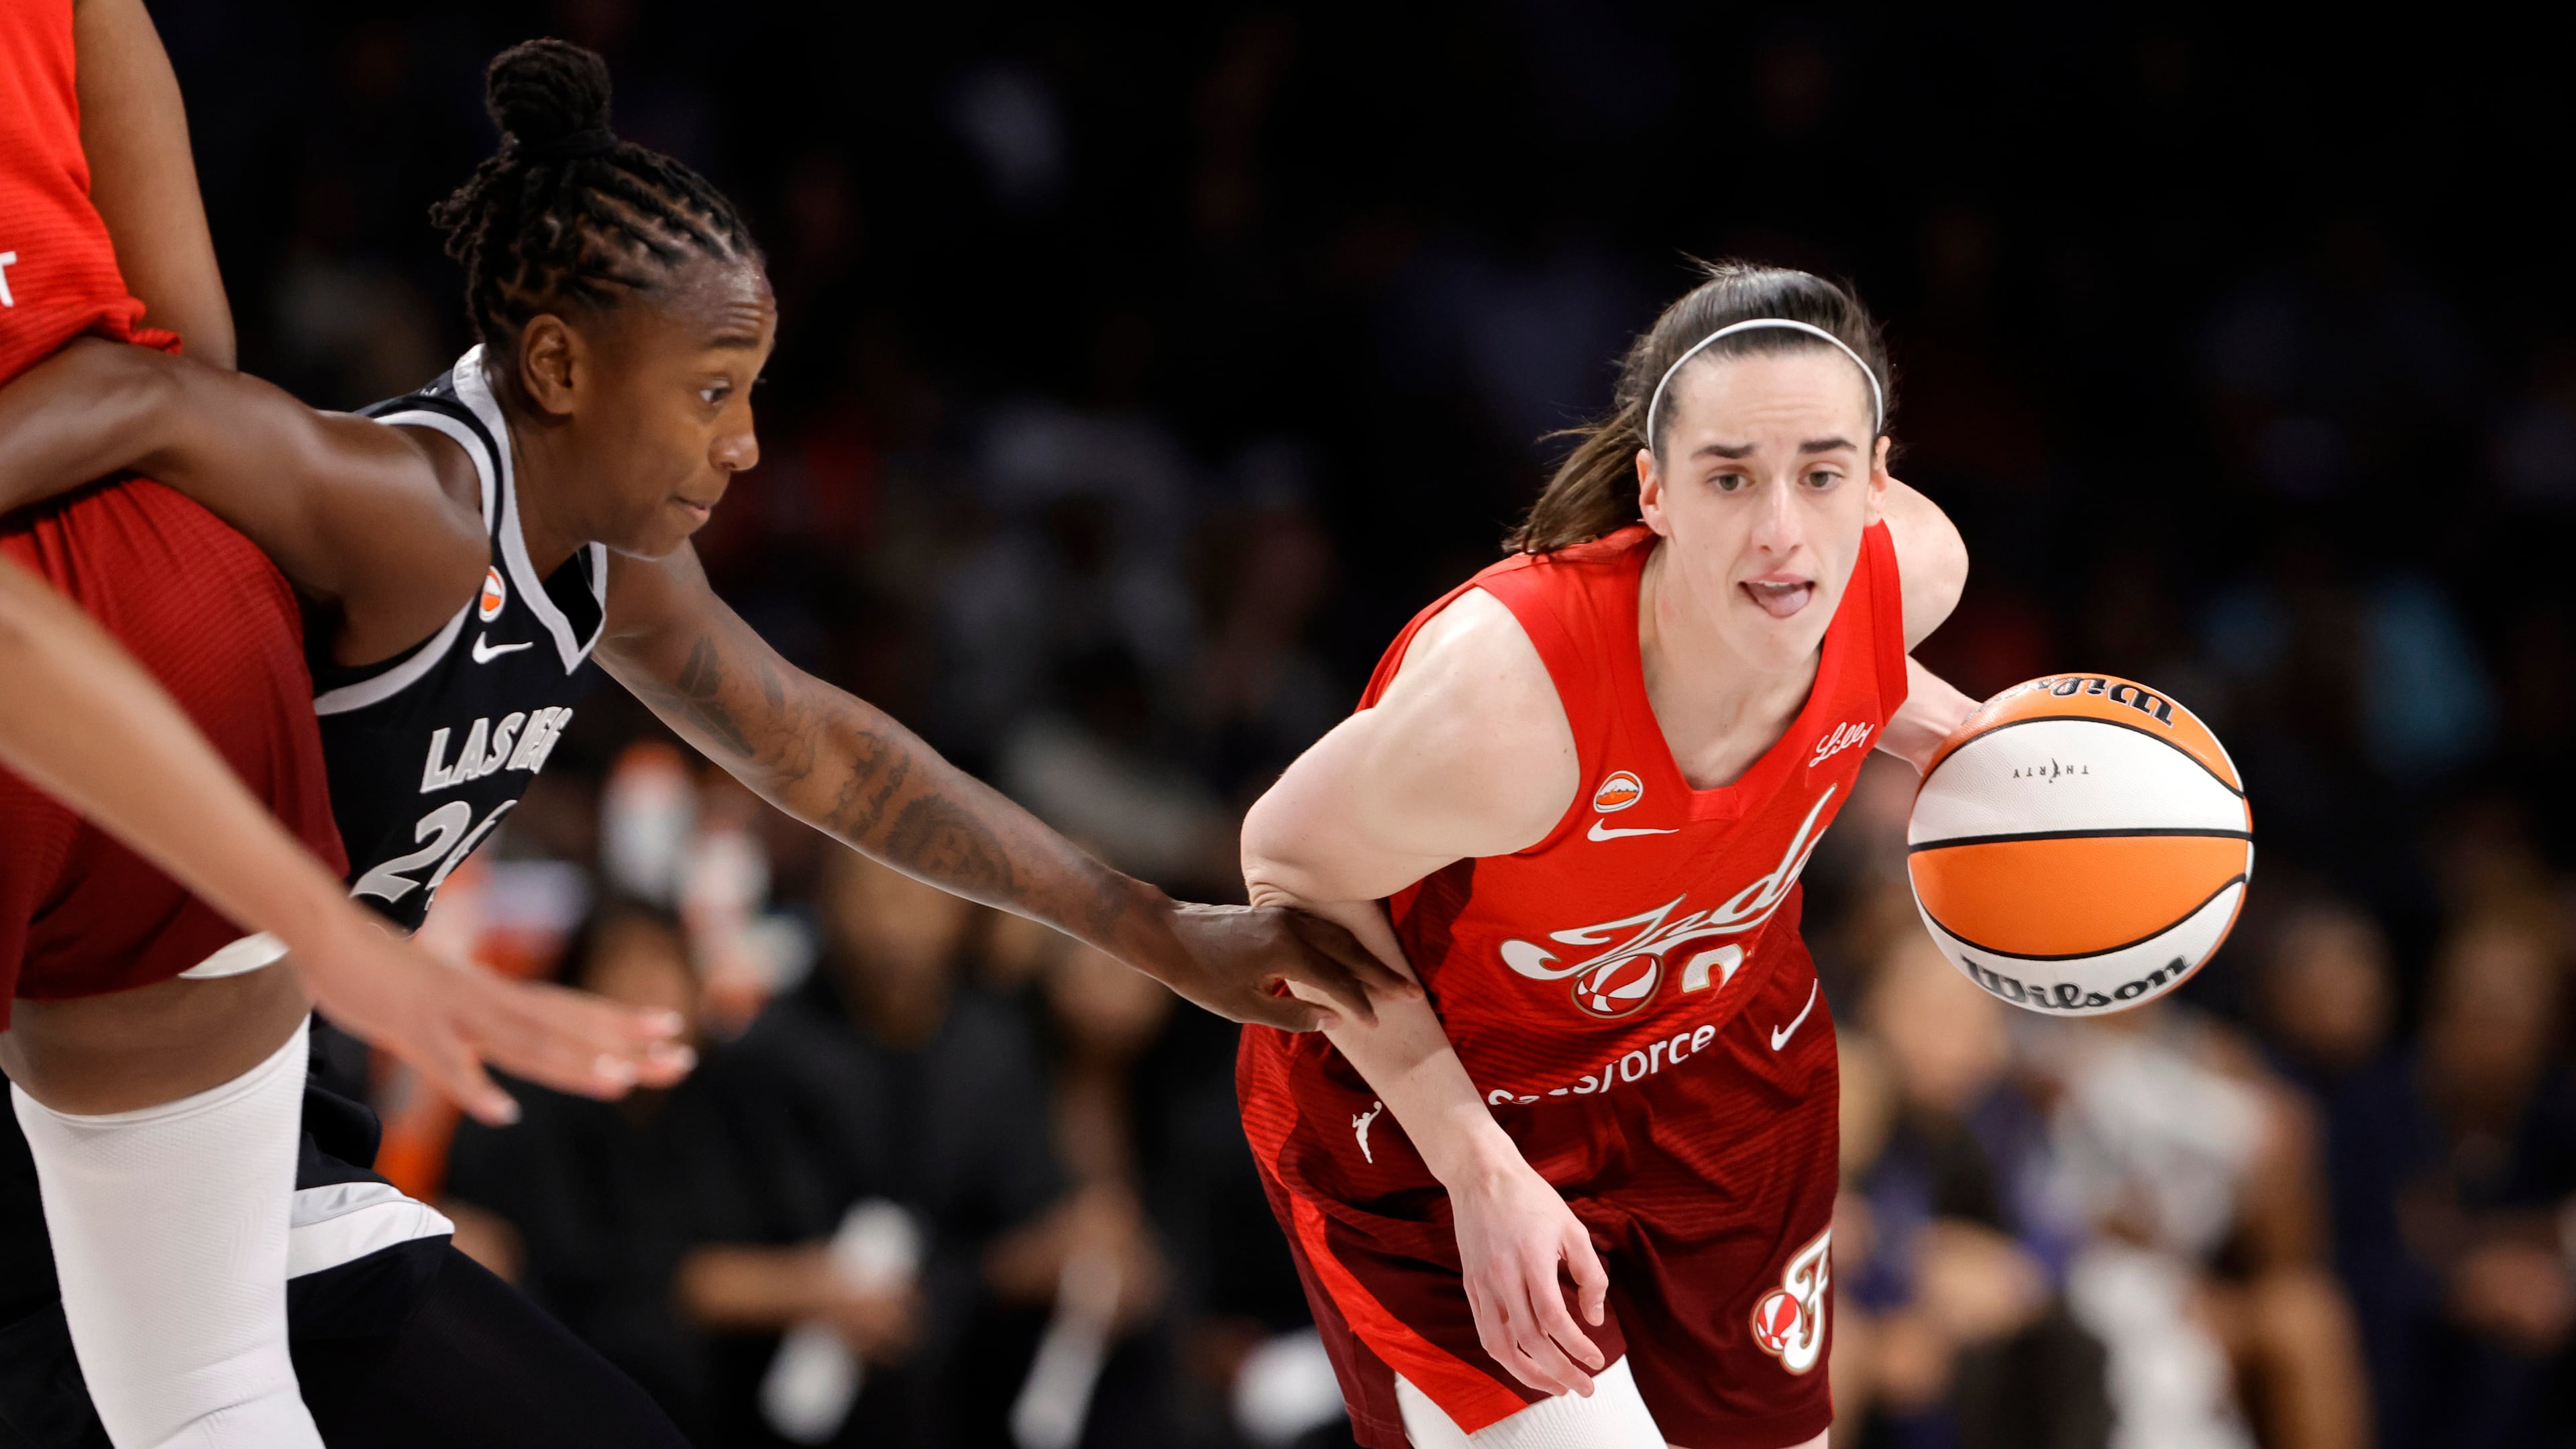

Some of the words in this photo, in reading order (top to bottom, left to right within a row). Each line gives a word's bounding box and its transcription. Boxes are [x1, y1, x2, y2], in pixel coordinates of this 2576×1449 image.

[419, 712, 527, 794] LAS
[1809, 722, 1875, 768] Lilly
[1960, 953, 2191, 1009] Wilson
